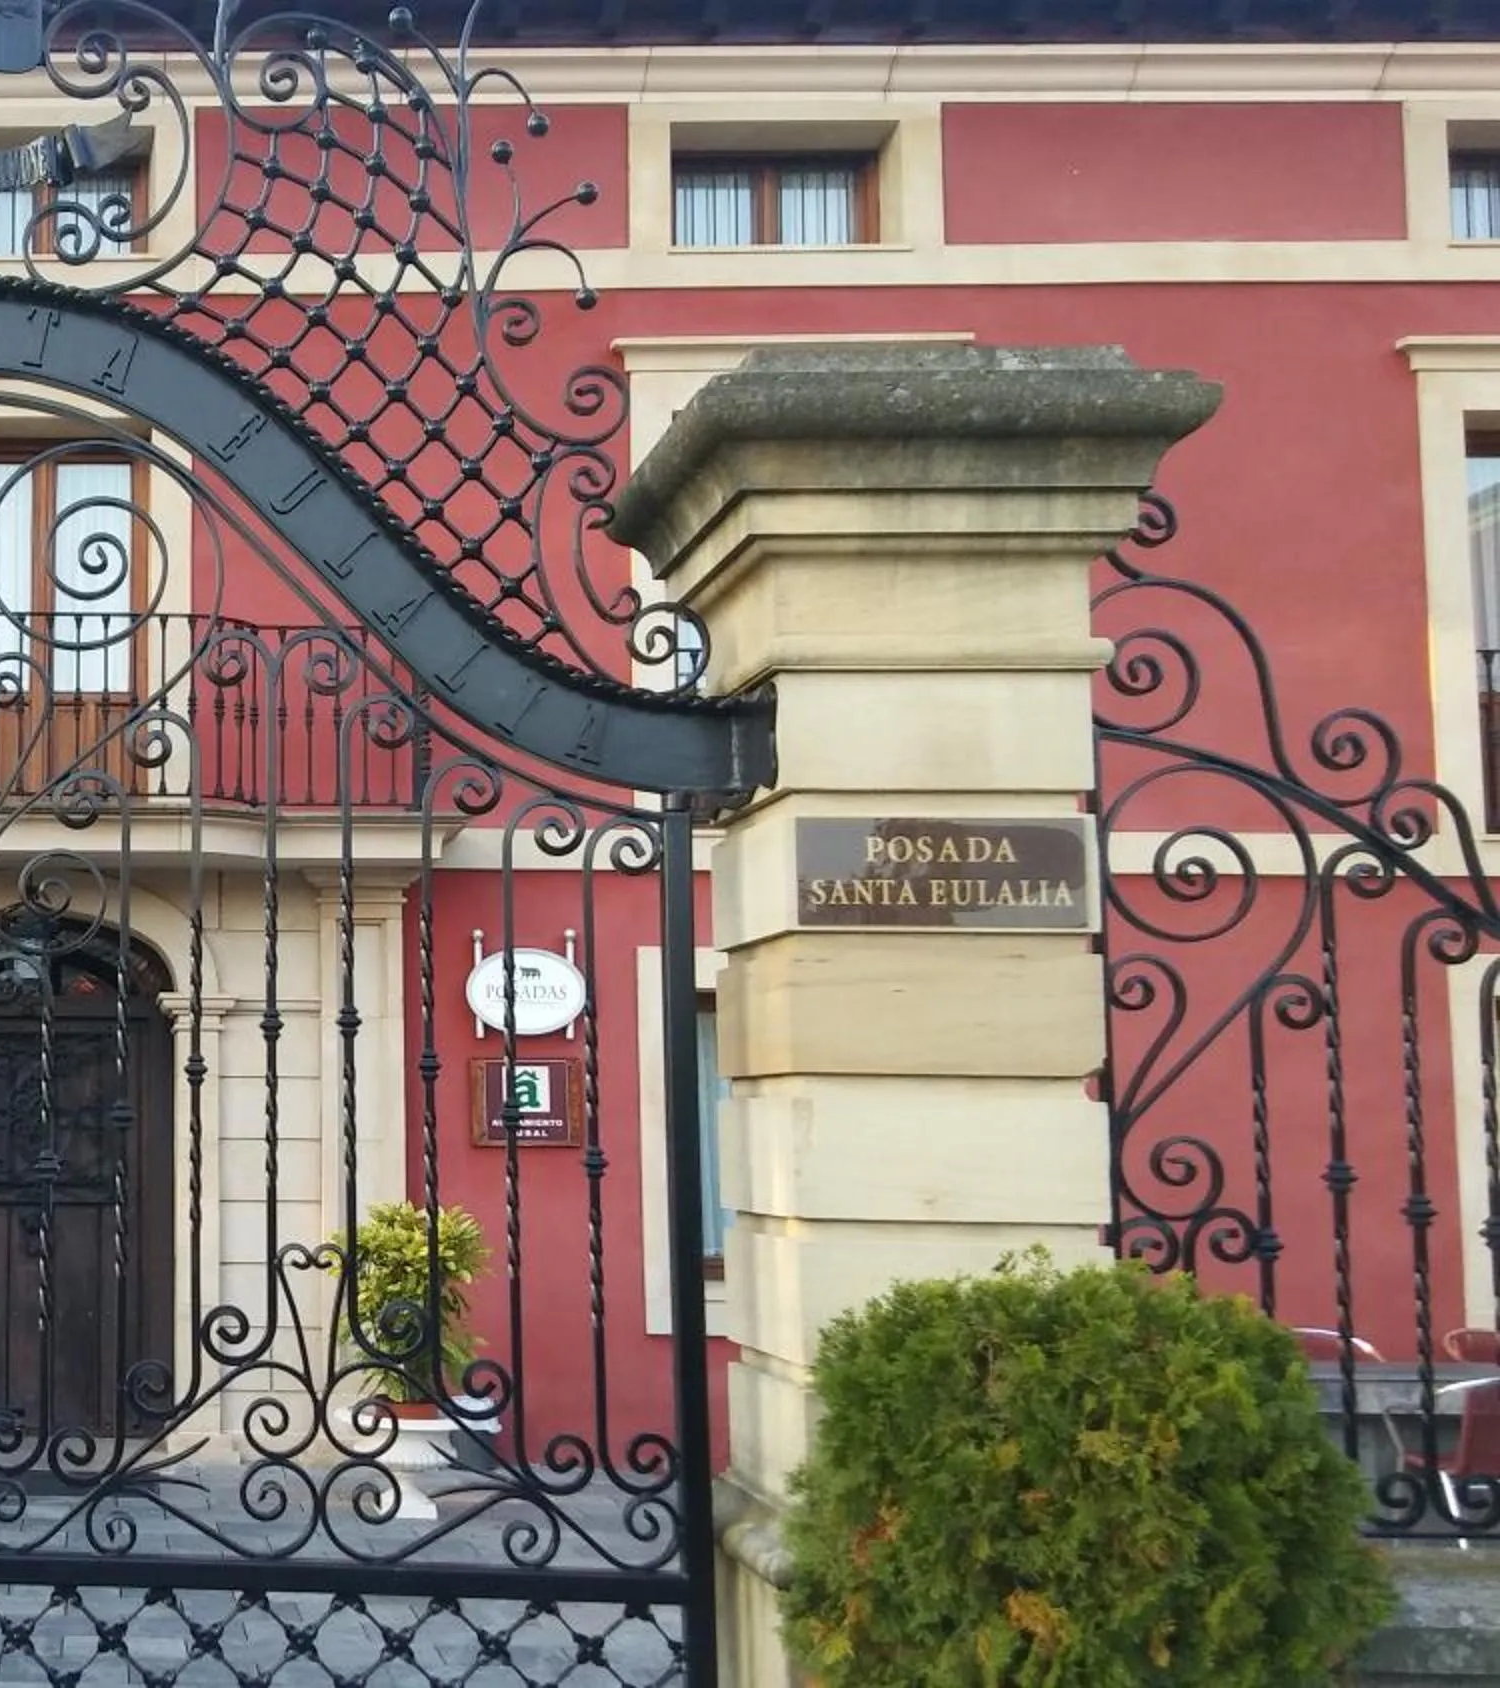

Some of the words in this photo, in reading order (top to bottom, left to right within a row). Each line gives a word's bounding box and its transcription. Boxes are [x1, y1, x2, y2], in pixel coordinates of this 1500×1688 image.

[208, 413, 607, 764] EULALIA
[865, 835, 1018, 863] POSADA
[810, 879, 918, 906] SANTA
[930, 878, 1075, 907] EULALIA
[491, 1119, 563, 1127] ALAMIENTO
[509, 1129, 548, 1137] URAL
